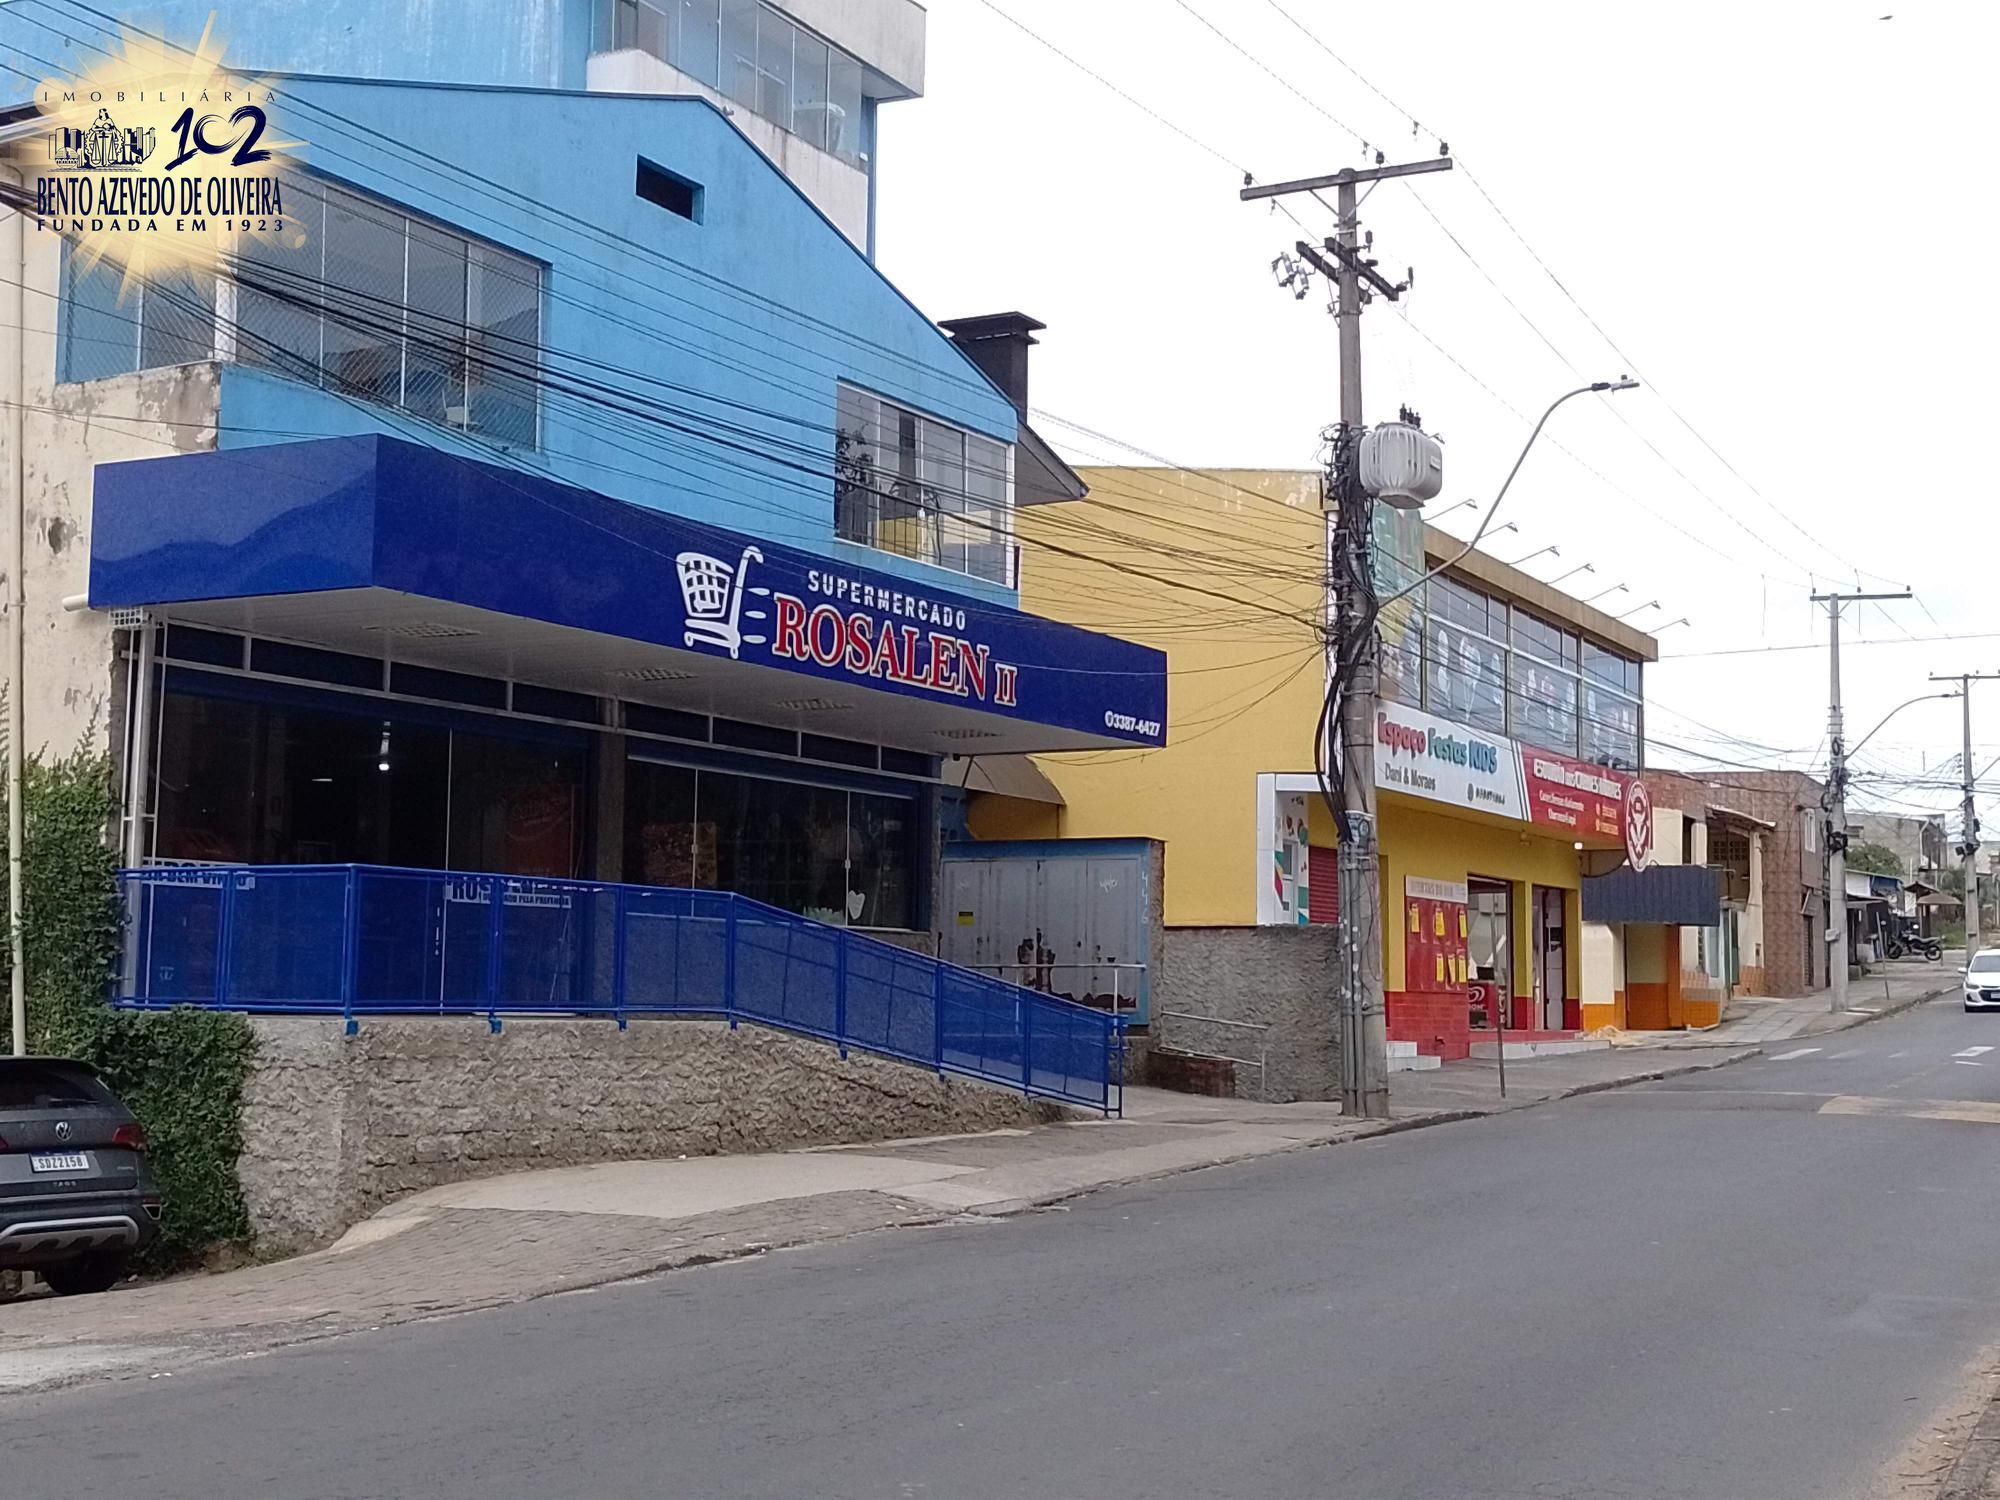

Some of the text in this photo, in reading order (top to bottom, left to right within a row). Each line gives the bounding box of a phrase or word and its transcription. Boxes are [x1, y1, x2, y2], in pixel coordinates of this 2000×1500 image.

[807, 569, 967, 632] SUPERMERCADO
[772, 592, 1019, 707] ROSALEN II
[1113, 713, 1161, 738] 3387-6427
[1377, 712, 1498, 774] Espaço Festas KIDS
